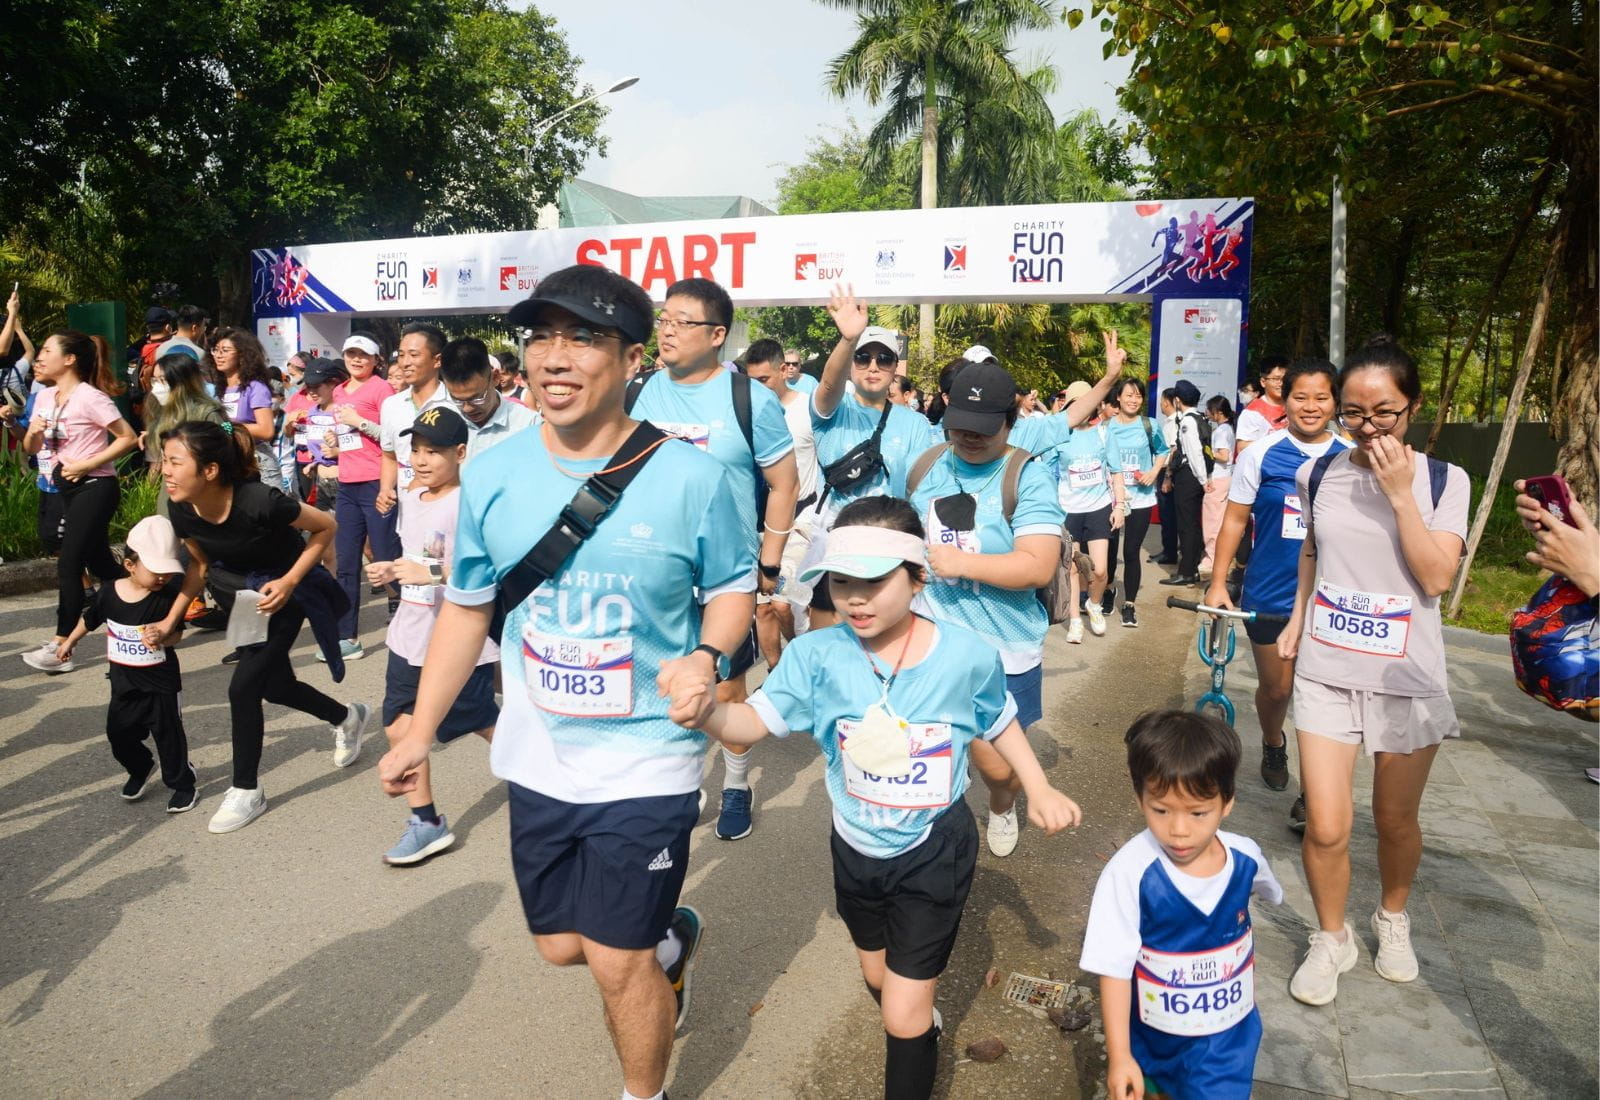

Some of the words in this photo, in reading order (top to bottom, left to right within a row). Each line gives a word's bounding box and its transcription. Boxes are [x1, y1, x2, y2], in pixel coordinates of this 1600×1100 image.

[1014, 221, 1064, 230] CHARITY
[1013, 231, 1064, 255] FUN
[376, 252, 408, 260] CHARITY
[376, 260, 408, 280] FUN
[818, 267, 844, 280] BUV
[1012, 257, 1063, 283] RUN
[375, 280, 408, 301] RUN
[517, 278, 539, 291] BUV
[1199, 316, 1217, 324] BUV
[551, 570, 635, 591] ARITY
[527, 587, 633, 636] FUN
[1328, 612, 1389, 639] 10583
[116, 641, 153, 656] 1469
[539, 668, 606, 696] 10183
[648, 860, 673, 871] adidas
[1159, 980, 1243, 1015] 16488
